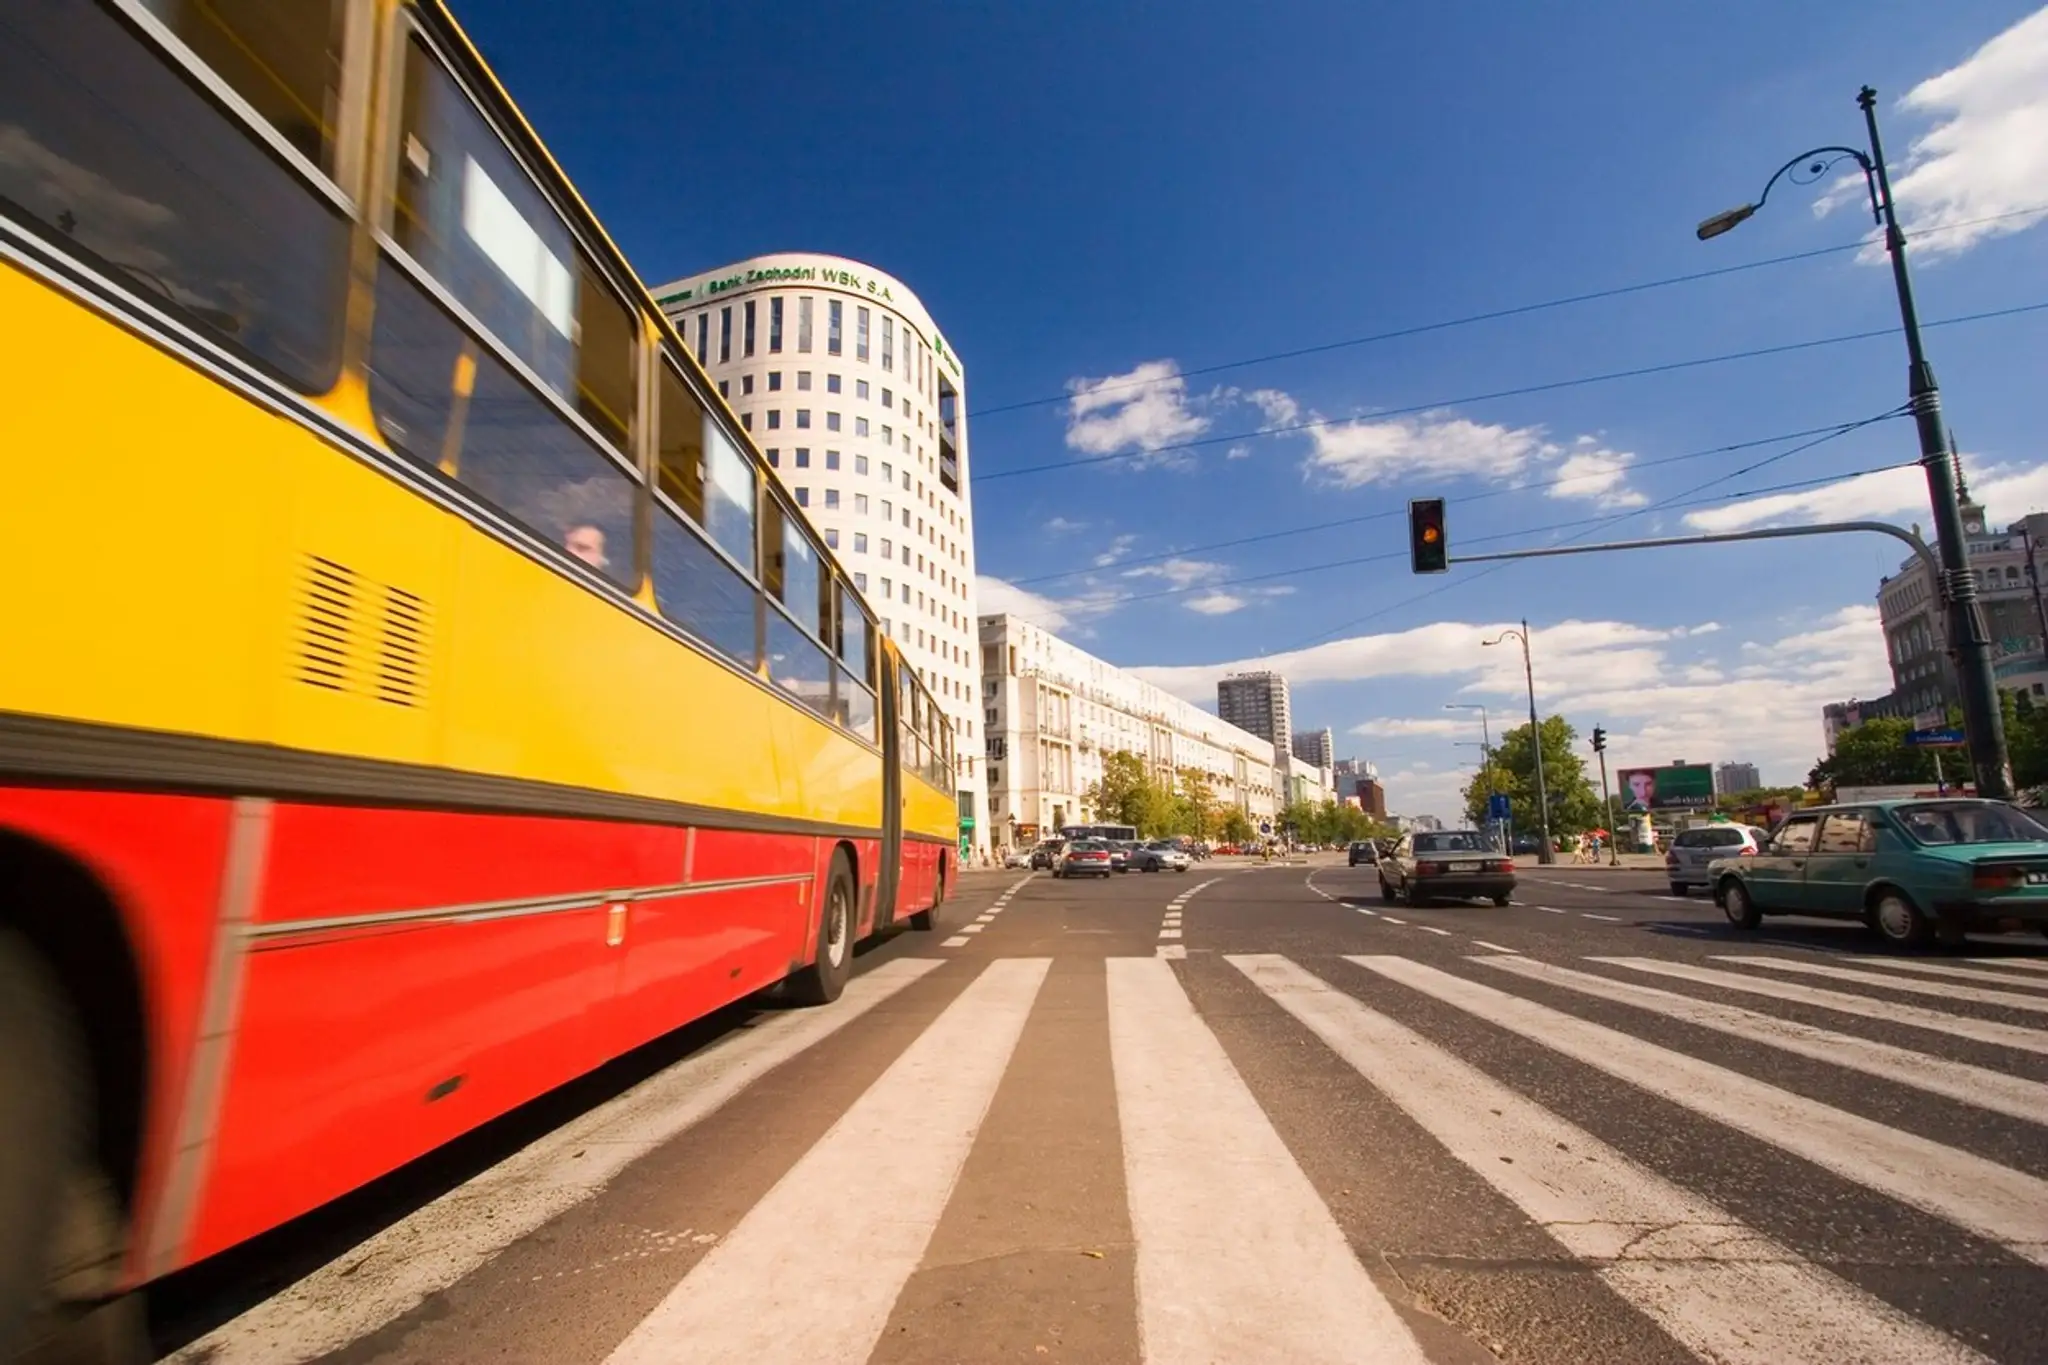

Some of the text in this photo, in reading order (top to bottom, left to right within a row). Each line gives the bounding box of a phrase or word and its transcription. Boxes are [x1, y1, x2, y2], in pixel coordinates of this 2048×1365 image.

[709, 275, 742, 294] Bank
[746, 266, 815, 284] Zachodni
[866, 279, 894, 302] S.A.
